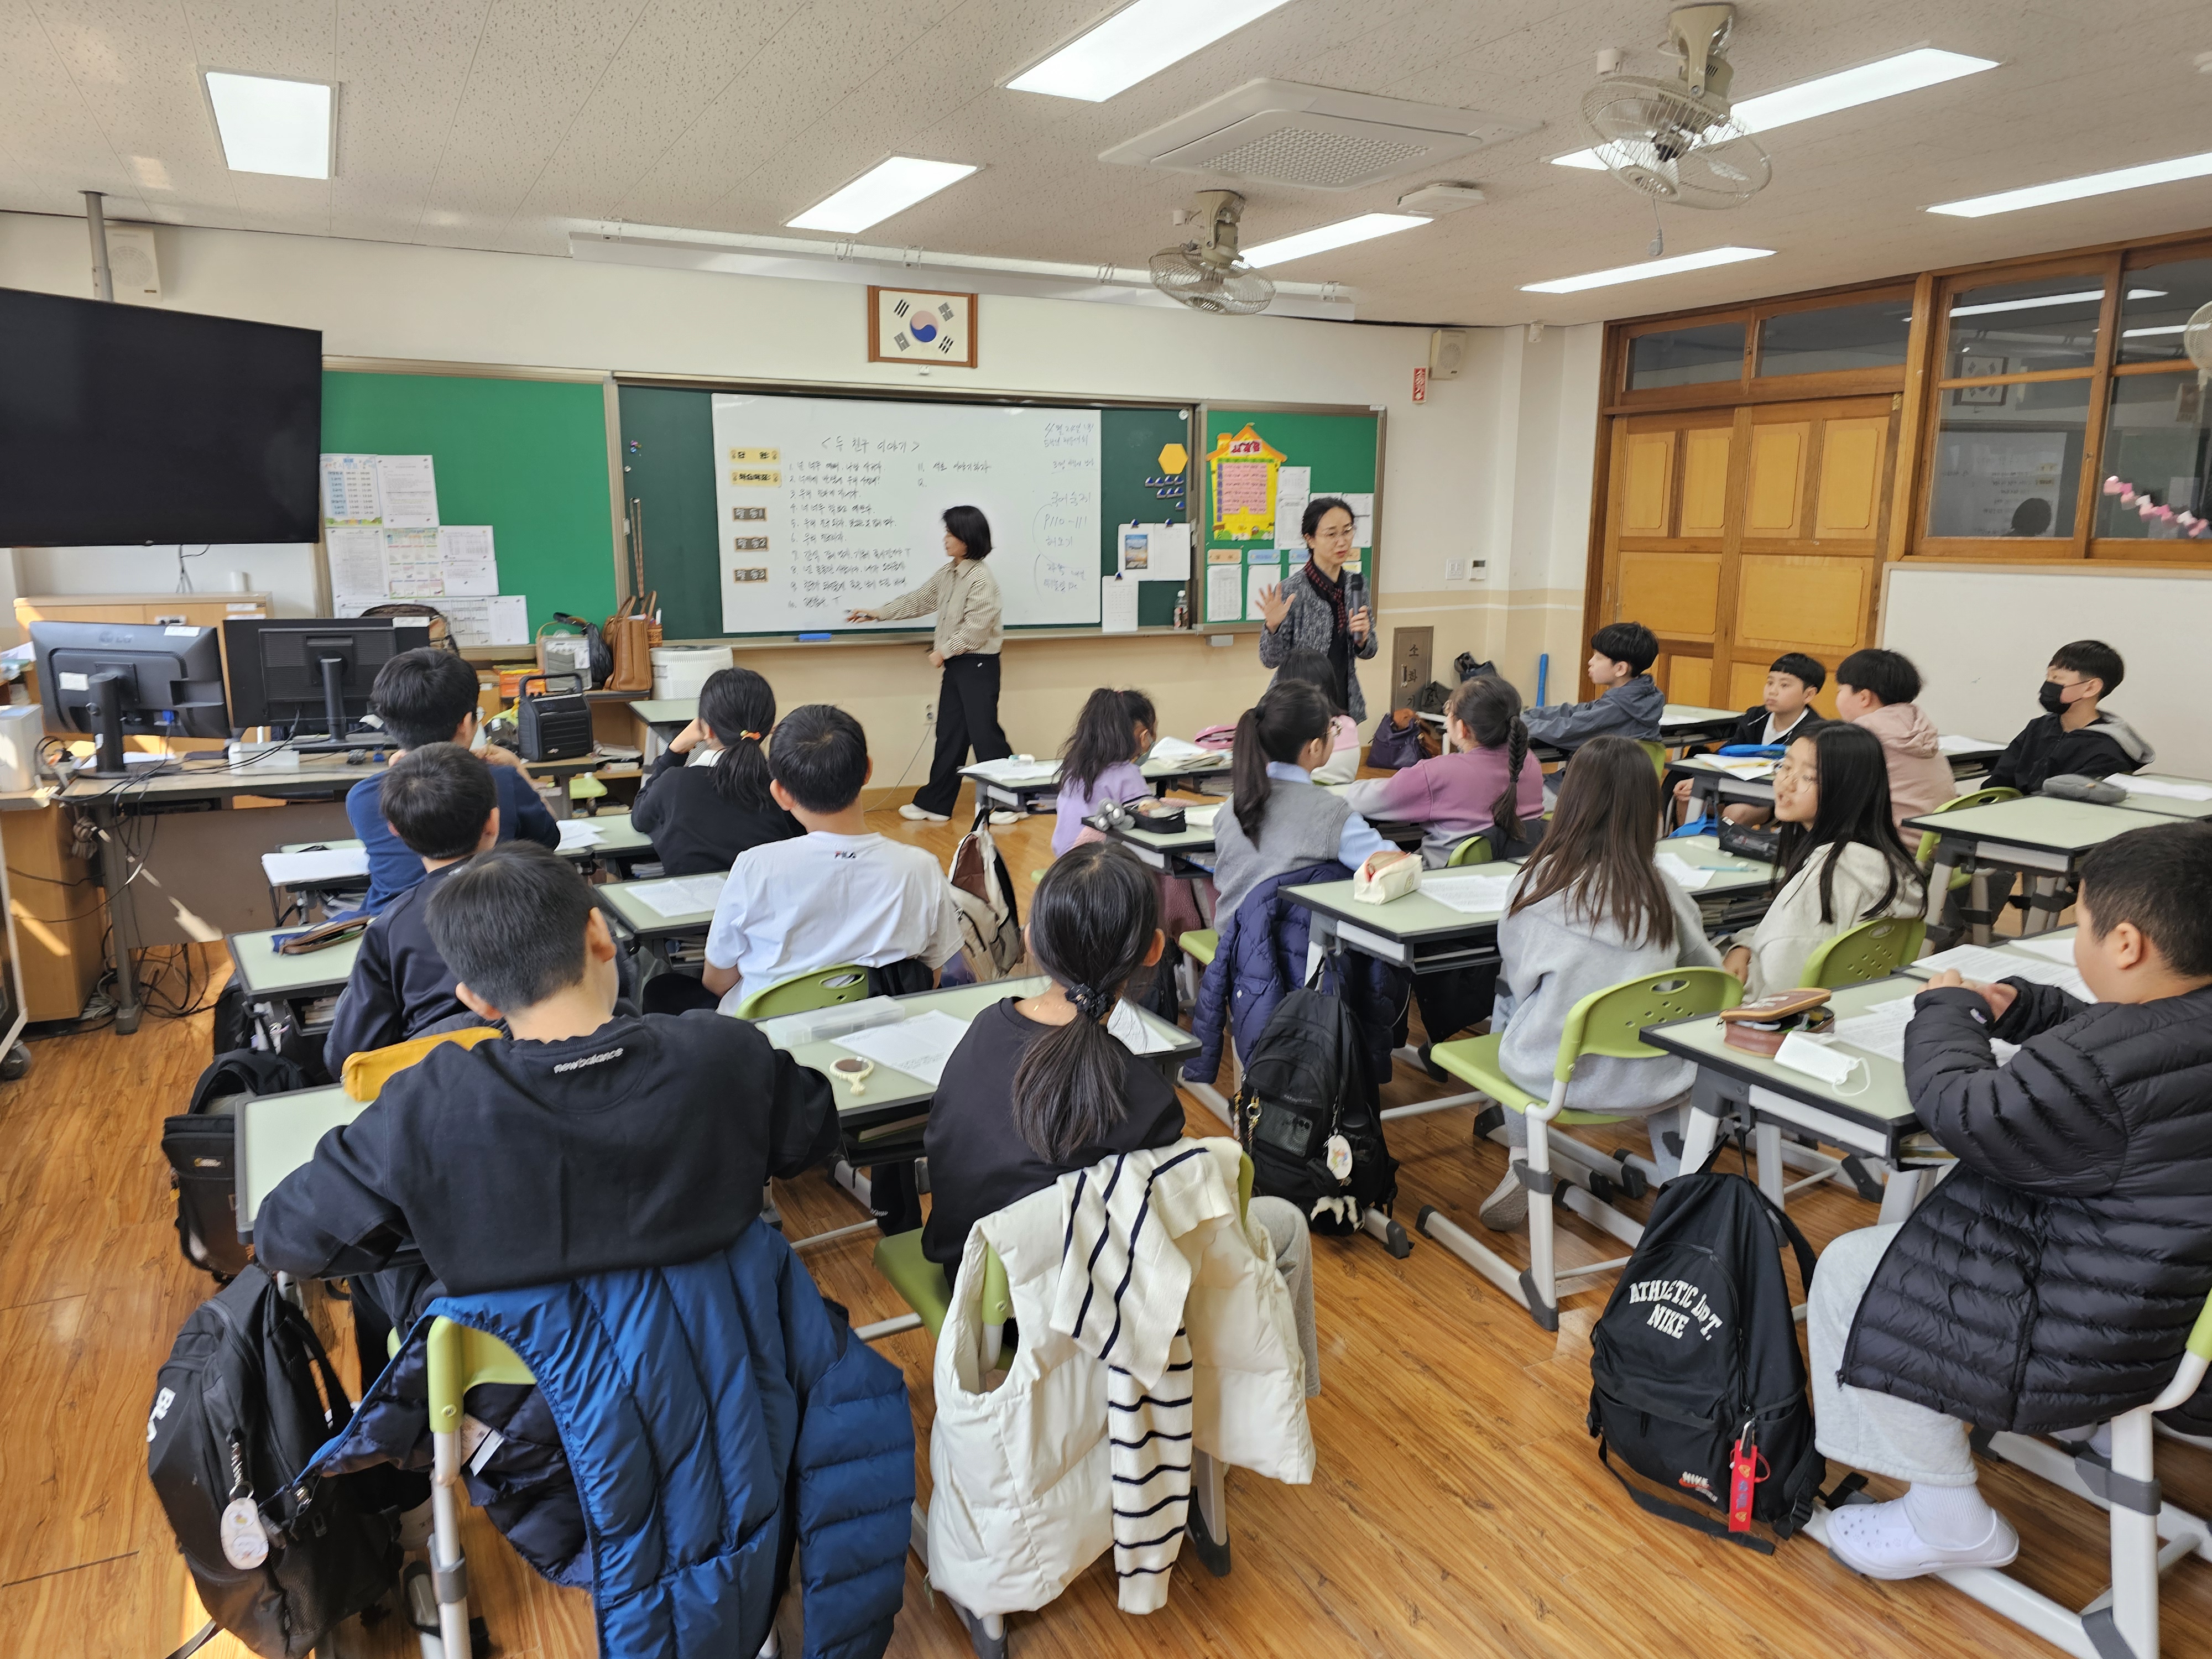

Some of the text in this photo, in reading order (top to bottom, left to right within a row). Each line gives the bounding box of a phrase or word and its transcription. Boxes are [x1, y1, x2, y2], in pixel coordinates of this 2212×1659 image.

[852, 436, 869, 453] 친구
[877, 439, 907, 453] 이야기
[834, 851, 857, 859] FILA
[1629, 1279, 1699, 1309] ATHLETIC
[1646, 1303, 1691, 1339] NIKE
